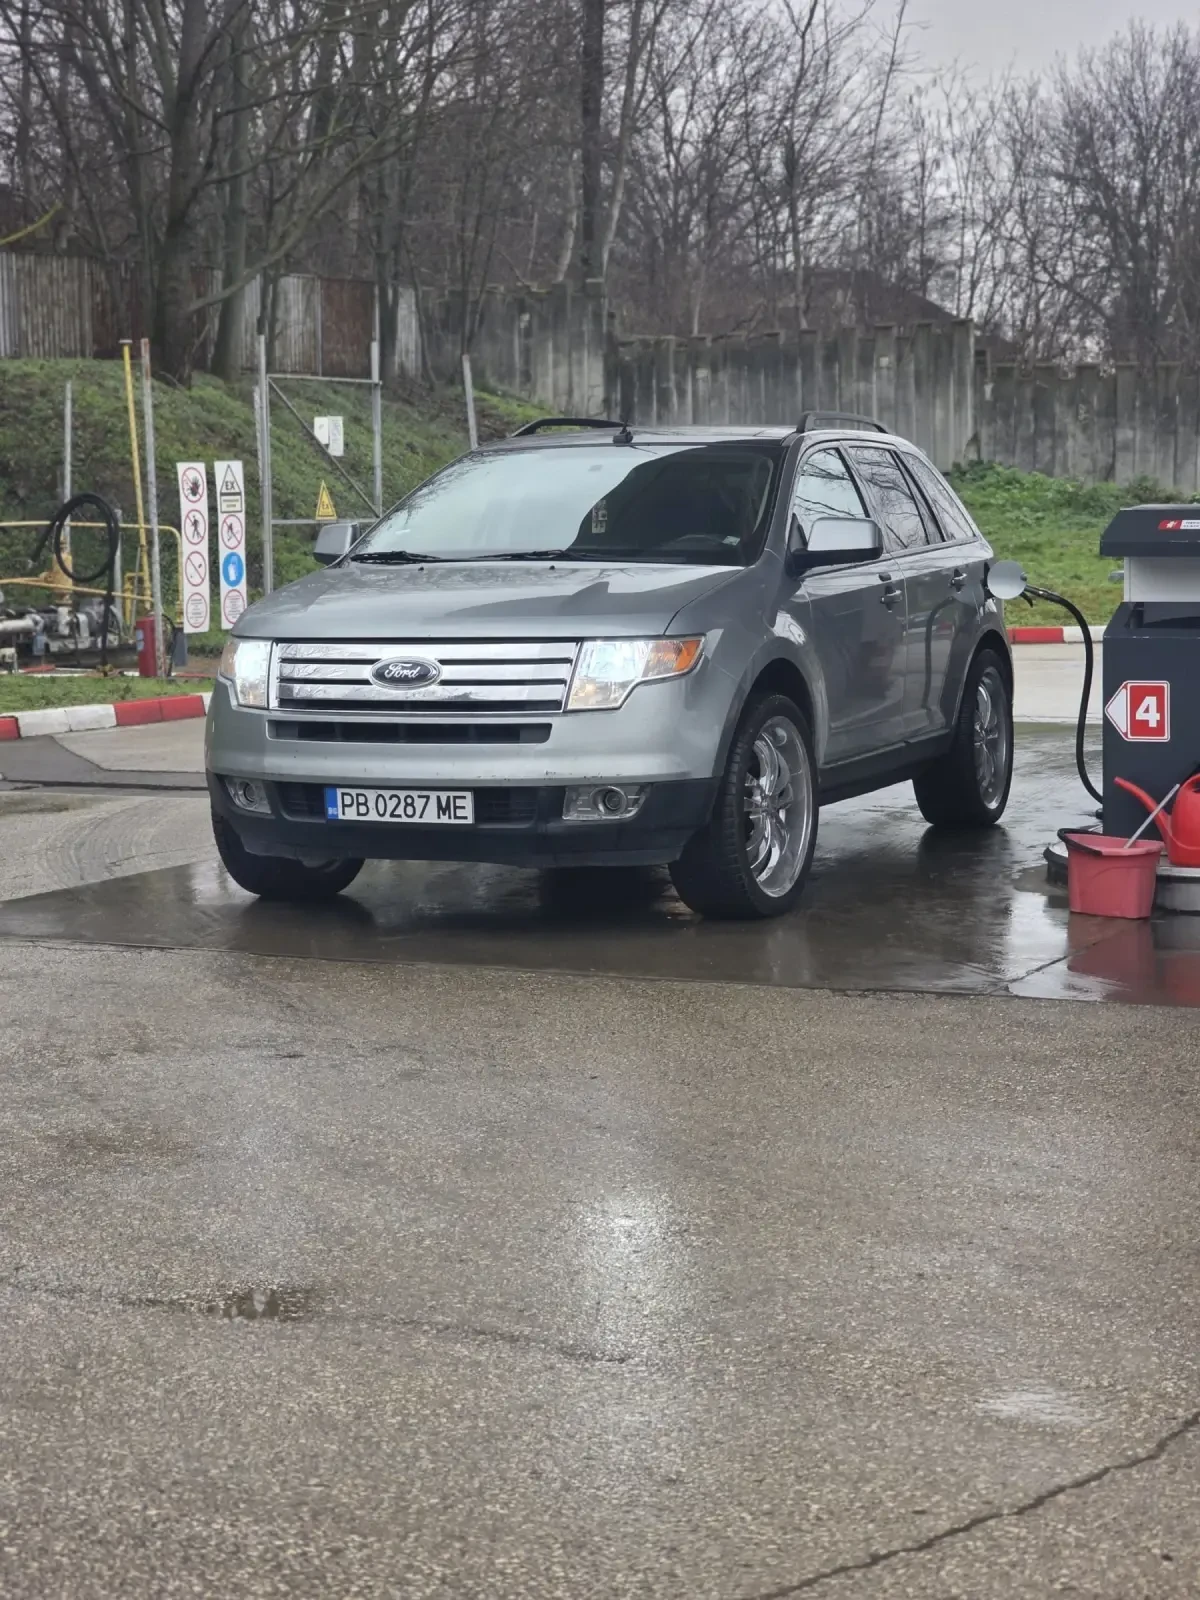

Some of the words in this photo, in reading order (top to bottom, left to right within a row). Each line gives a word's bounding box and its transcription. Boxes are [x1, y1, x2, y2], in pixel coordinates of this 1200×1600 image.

[225, 481, 236, 490] EX
[384, 663, 421, 678] Ford
[1136, 696, 1160, 728] 4
[340, 791, 370, 817] PB
[375, 793, 430, 819] 0287
[436, 795, 468, 820] ME
